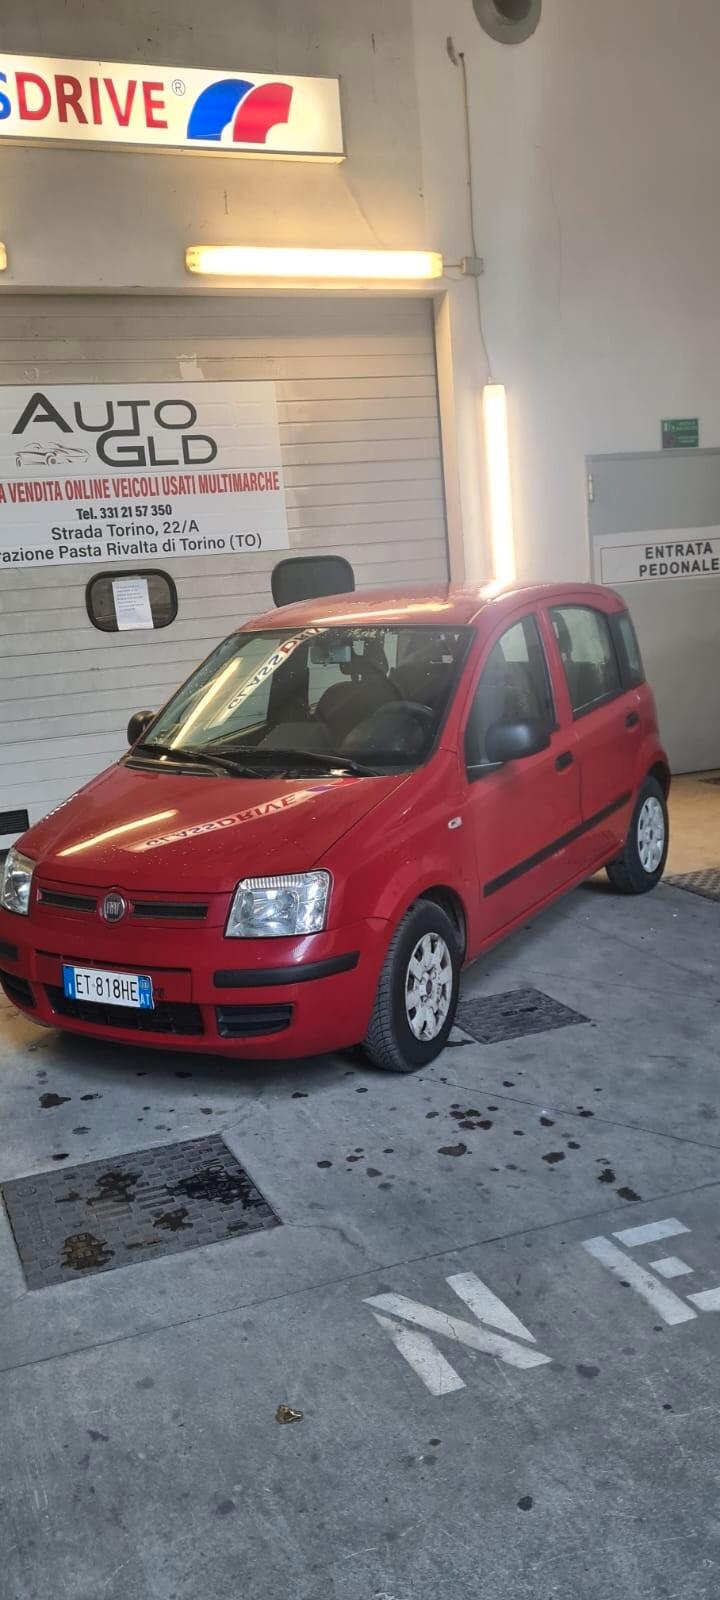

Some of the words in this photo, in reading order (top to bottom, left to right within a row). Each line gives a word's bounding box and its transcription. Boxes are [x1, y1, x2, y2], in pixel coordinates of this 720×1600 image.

[12, 392, 197, 434] AUTO
[96, 430, 217, 467] GLD
[8, 481, 62, 503] VENDITA
[65, 479, 111, 500] ONLINE
[112, 477, 160, 498] VEICOLI
[162, 475, 196, 496] USATI
[198, 471, 280, 494] MULTIMARCHE
[76, 507, 98, 520] Tel.
[100, 507, 119, 519] 331
[121, 506, 133, 518] 21
[135, 505, 148, 517] 57
[151, 504, 172, 516] 350
[51, 524, 103, 540] Strada
[106, 522, 159, 538] Torino,
[163, 519, 200, 534] 22/A
[0, 547, 54, 563] azione
[59, 544, 102, 559] Pasta
[106, 540, 158, 556] Rivalta
[162, 538, 176, 552] di
[179, 536, 225, 551] Torino
[230, 532, 262, 551] (TO)
[645, 541, 713, 559] ENTRATA
[639, 558, 720, 577] PEDONALE
[140, 993, 150, 1006] AT
